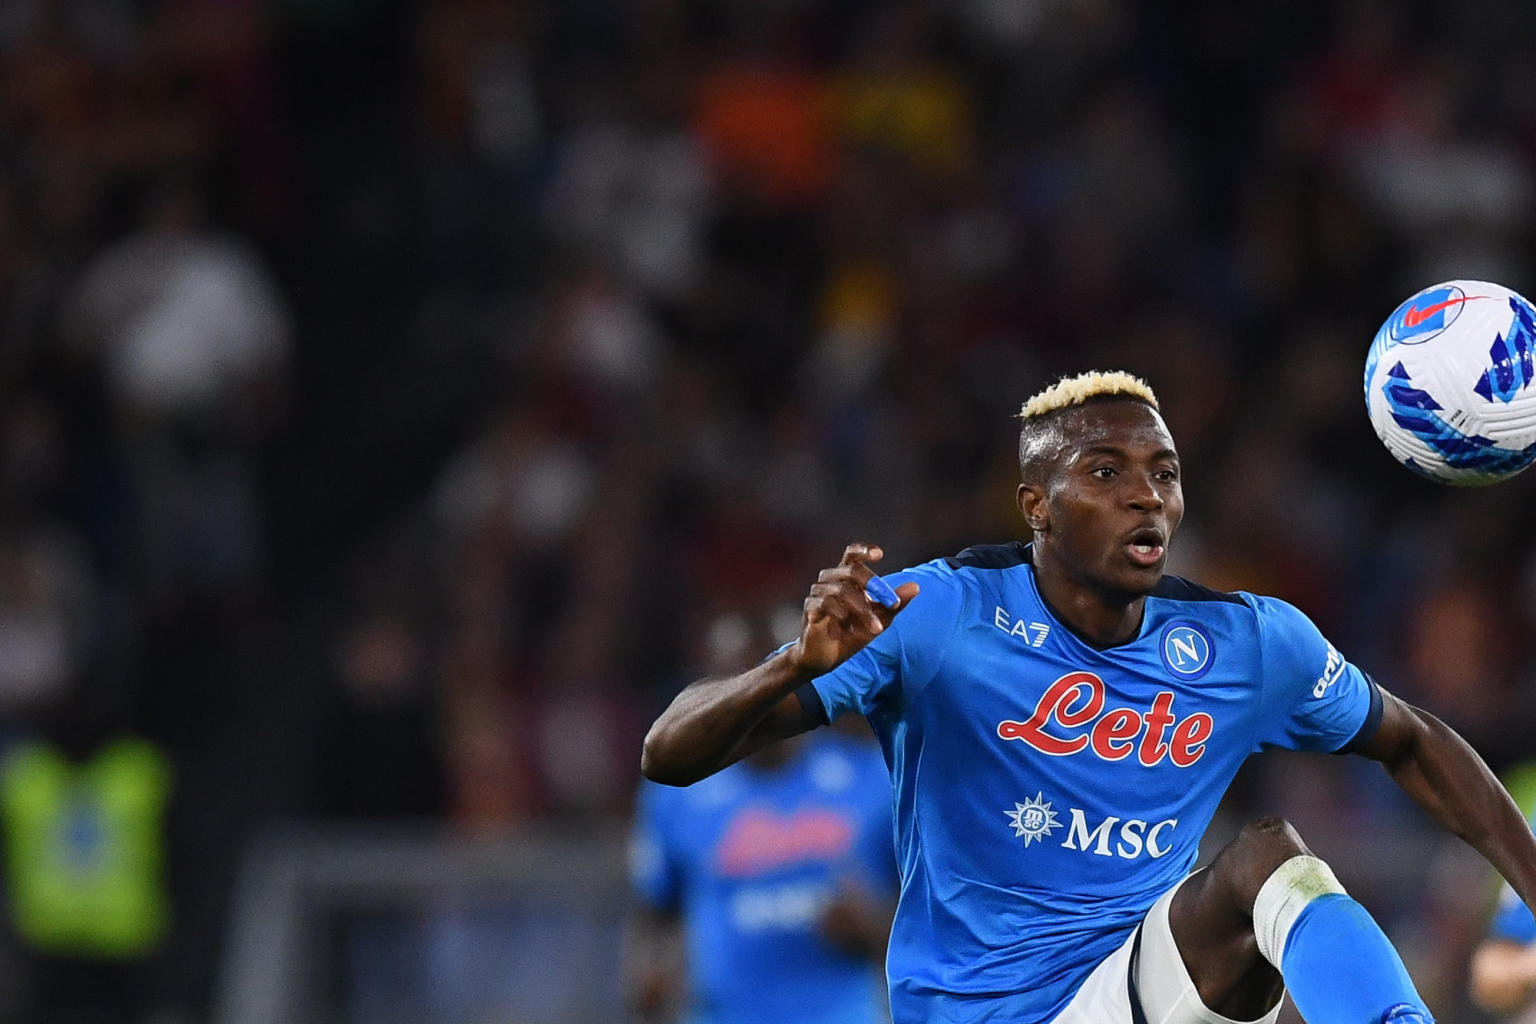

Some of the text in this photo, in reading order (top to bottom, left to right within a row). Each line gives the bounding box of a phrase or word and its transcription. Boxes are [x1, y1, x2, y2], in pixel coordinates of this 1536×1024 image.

[995, 605, 1050, 648] EA7
[1171, 634, 1199, 666] N
[997, 671, 1214, 767] Lete
[1061, 808, 1178, 860] MSC
